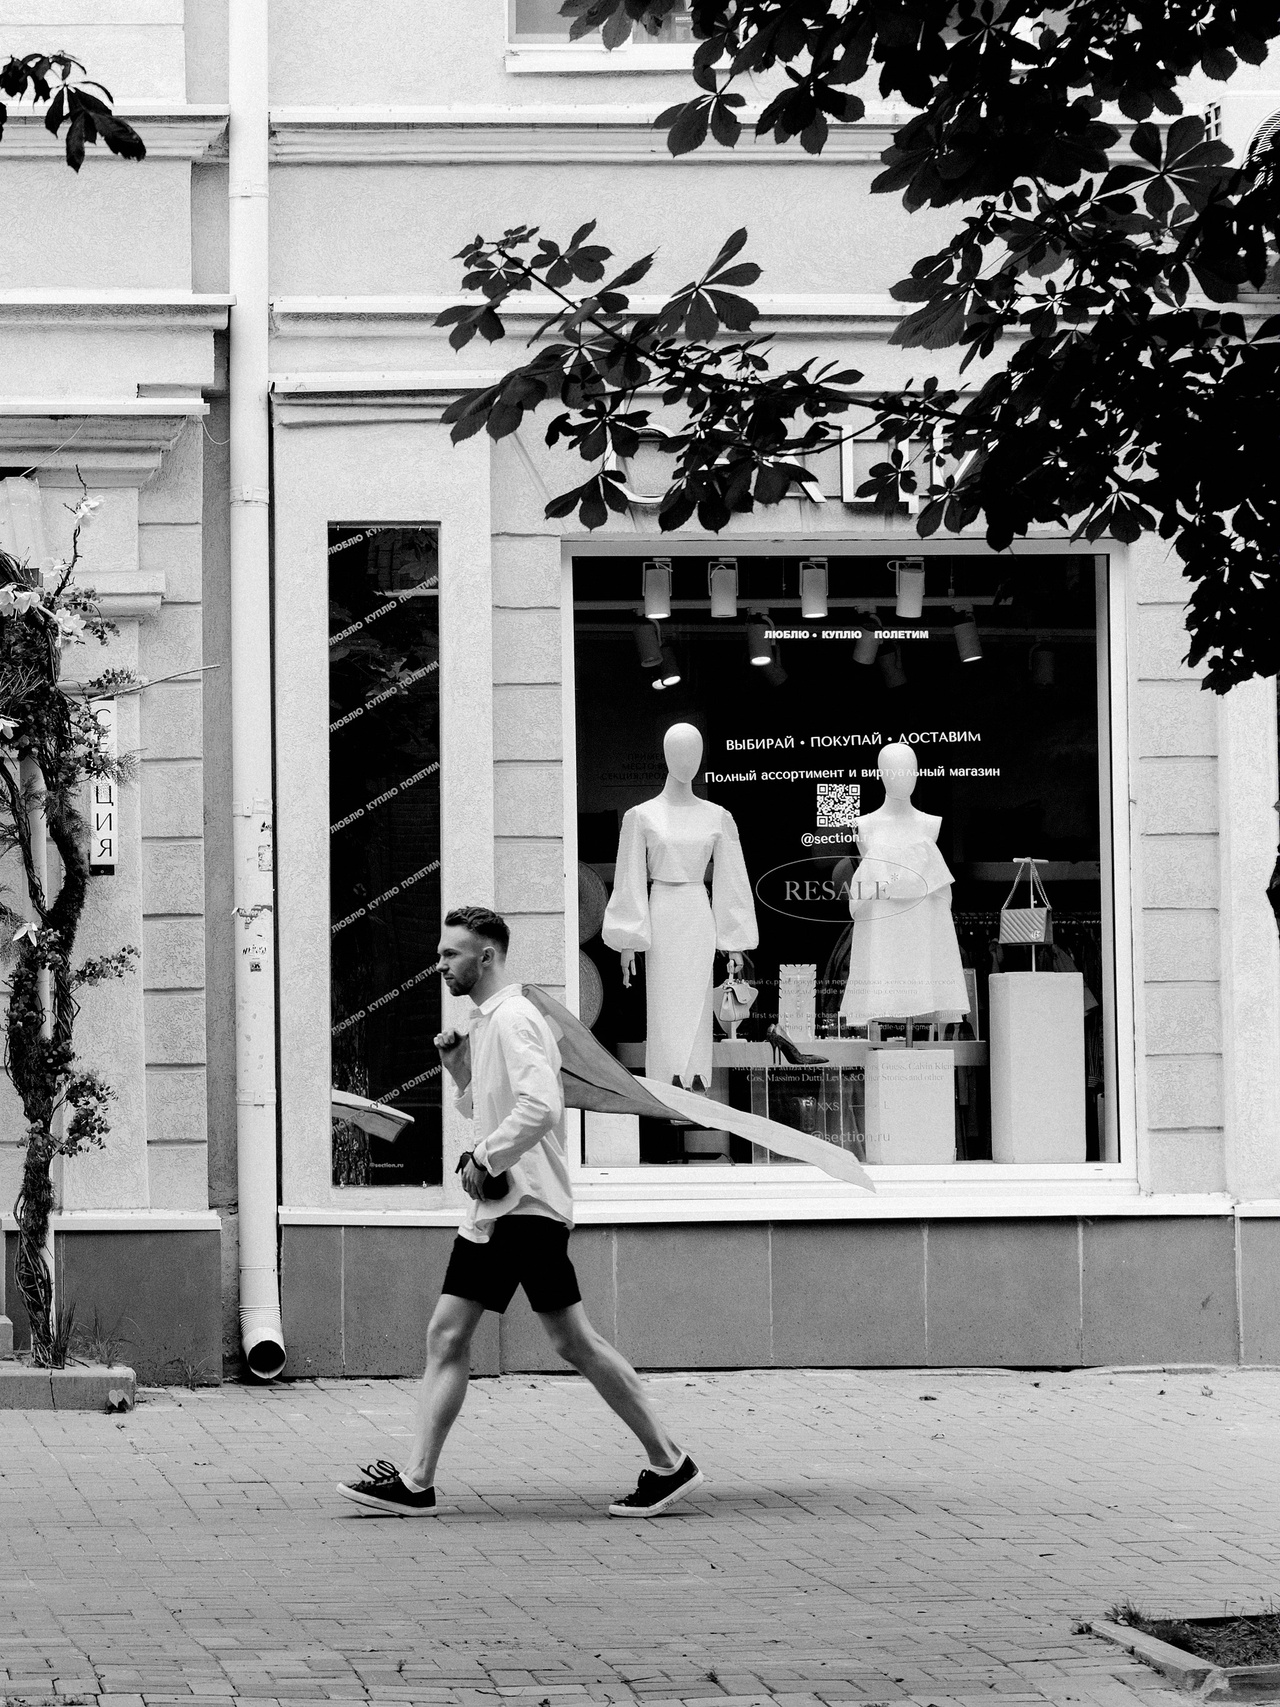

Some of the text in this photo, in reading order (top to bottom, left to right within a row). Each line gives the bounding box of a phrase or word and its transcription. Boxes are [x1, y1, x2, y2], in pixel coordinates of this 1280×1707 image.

[328, 621, 363, 646] ЛЮБЛЮ
[364, 600, 397, 624] КУПЛЮ
[764, 630, 929, 639] ЛЮБЛЮ КУПЛЮ ПОЛЕТИМ
[329, 660, 439, 732] ЛЮБЛЮ КУПЛЮ ПОЛЕТИМ
[726, 731, 981, 750] ВЫБИРАЙ ПОКУПАЙ ДОСТАВИМ
[705, 766, 1000, 783] Полный ассортимент и виртуальный магазин
[330, 761, 440, 834] ЛЮБЛЮ КУПЛЮ ПОЛЕТИМ
[801, 832, 869, 847] @section.r
[331, 908, 366, 934] ЛЮБЛЮ
[401, 860, 440, 889] ПОЛЕТИМ
[367, 988, 399, 1013] КУПЛЮ
[401, 1064, 441, 1091] ПОЛЕТИМ
